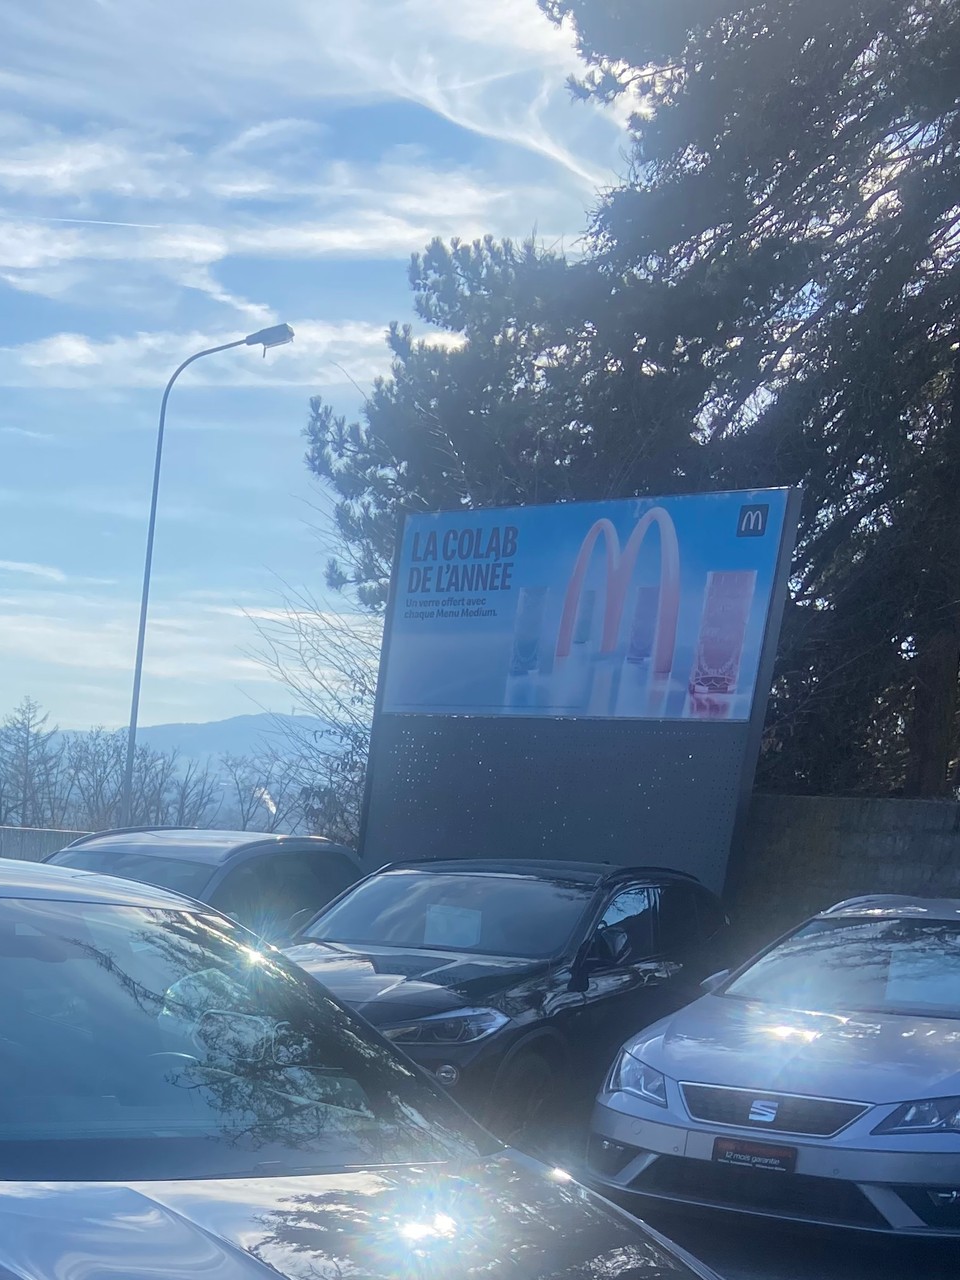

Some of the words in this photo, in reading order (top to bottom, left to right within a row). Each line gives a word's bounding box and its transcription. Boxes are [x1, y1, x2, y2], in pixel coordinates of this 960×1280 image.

[411, 531, 438, 562] LA
[442, 526, 519, 560] COLAB
[407, 566, 433, 594] DE
[405, 599, 418, 607] Un
[419, 599, 440, 608] verre
[441, 597, 465, 606] offert
[466, 598, 487, 606] avec
[403, 610, 435, 620] chaque
[436, 609, 460, 618] Menu
[733, 1153, 750, 1161] mois
[751, 1156, 780, 1165] garantie
